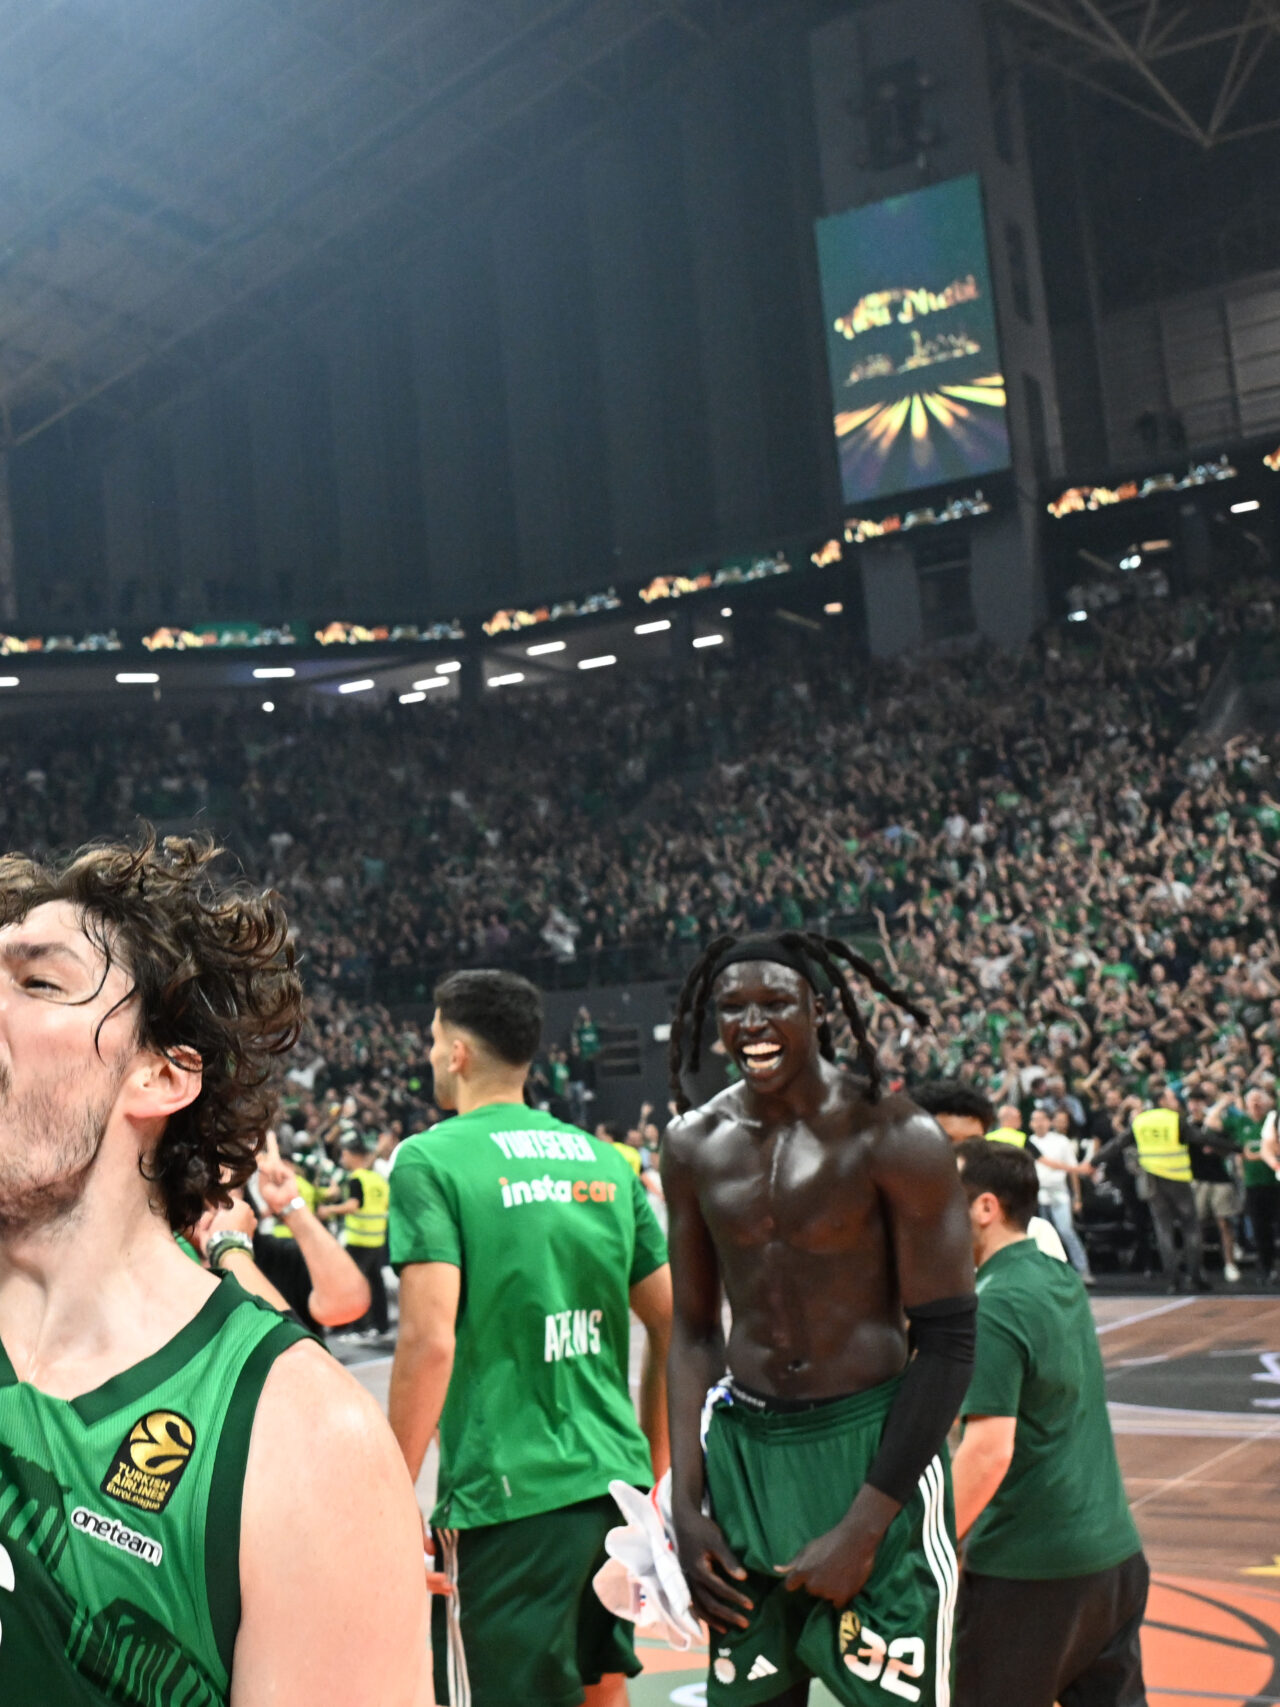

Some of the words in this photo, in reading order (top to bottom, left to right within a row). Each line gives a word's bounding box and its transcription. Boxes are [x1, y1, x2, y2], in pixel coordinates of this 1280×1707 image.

[498, 1174, 617, 1208] instacar
[111, 1472, 166, 1502] AIRLINES
[119, 1461, 171, 1493] TURKISH
[72, 1509, 162, 1563] oneteam
[843, 1626, 926, 1703] 32
